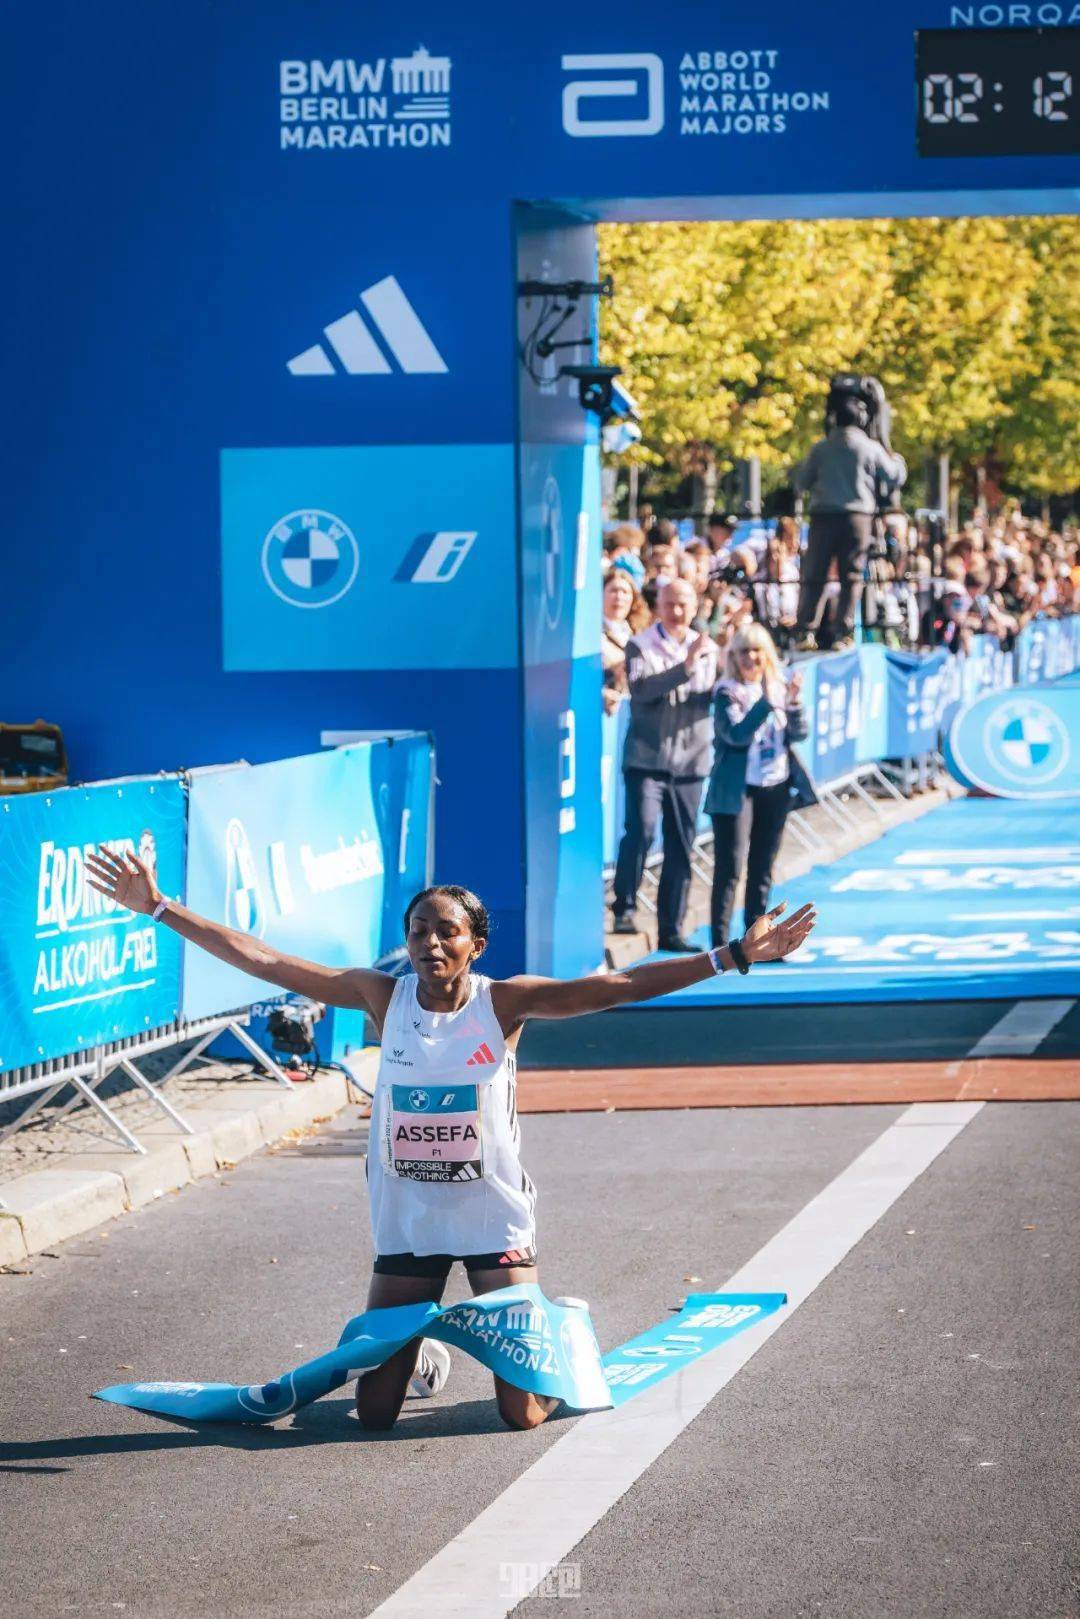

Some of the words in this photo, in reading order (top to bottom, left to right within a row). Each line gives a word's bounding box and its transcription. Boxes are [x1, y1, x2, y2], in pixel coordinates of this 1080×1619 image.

[679, 50, 778, 70] ABBOTT
[280, 58, 387, 95] BMW
[679, 71, 770, 91] WORLD
[280, 96, 388, 122] BERLIN
[680, 92, 830, 113] MARATHON
[680, 113, 786, 135] MAJORS
[280, 122, 450, 149] MARATHON
[396, 1125, 478, 1143] ASSEFA
[432, 1148, 442, 1157] F1
[396, 1161, 452, 1172] IMPOSSIBLE
[407, 1171, 450, 1181] NOTHING
